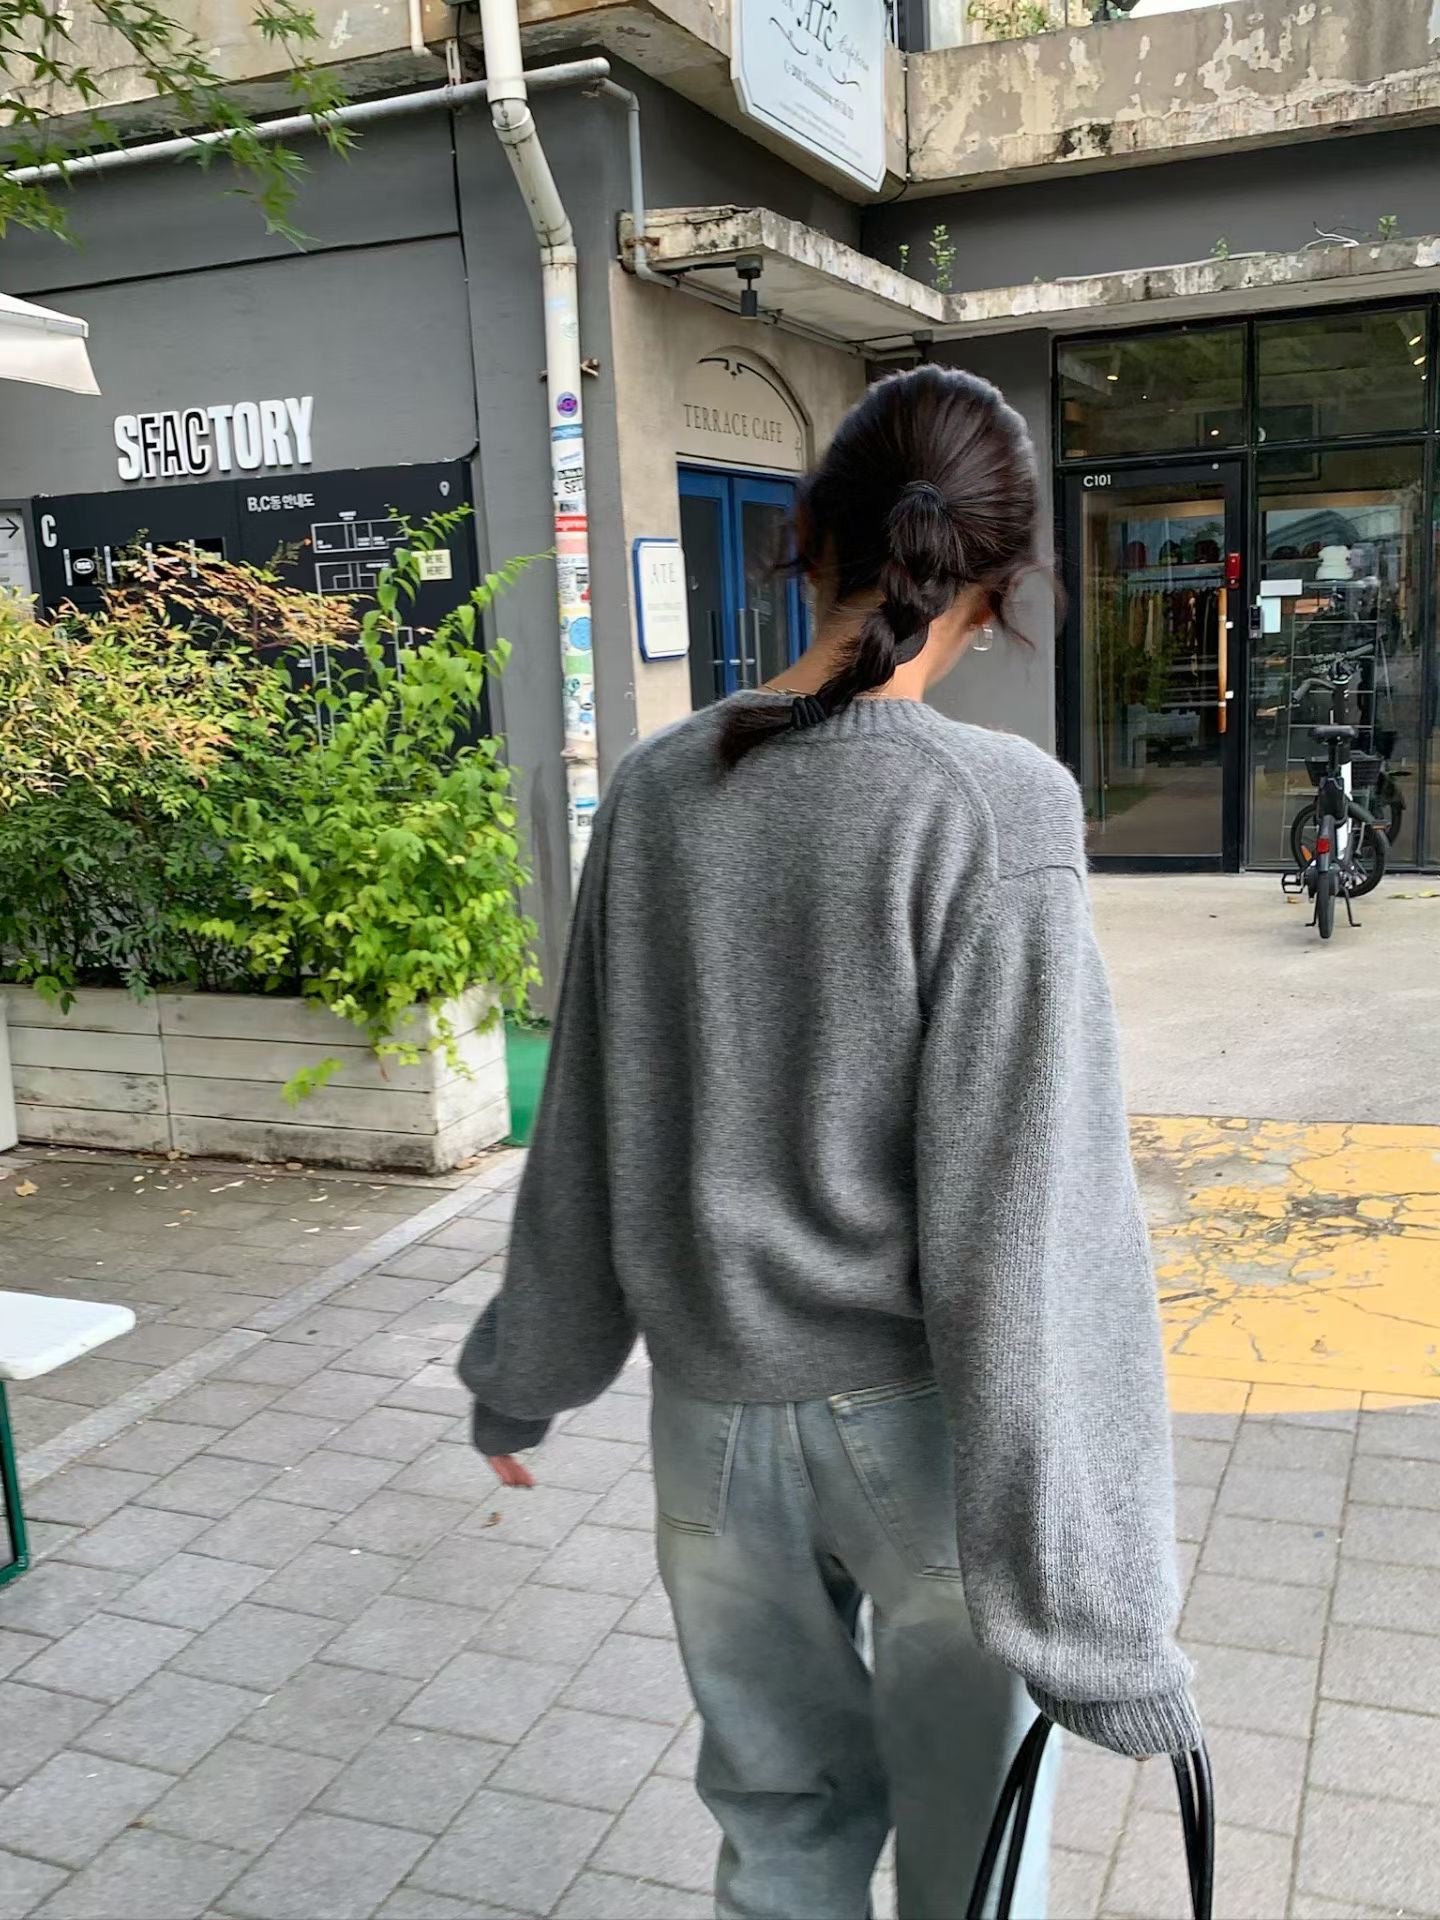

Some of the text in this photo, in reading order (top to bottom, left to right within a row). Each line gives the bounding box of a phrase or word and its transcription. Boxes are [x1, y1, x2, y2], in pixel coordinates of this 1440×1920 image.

[114, 396, 314, 481] SFACTORY
[683, 403, 783, 443] TERRACE CAFE
[1083, 474, 1112, 487] C101
[41, 514, 57, 548] C
